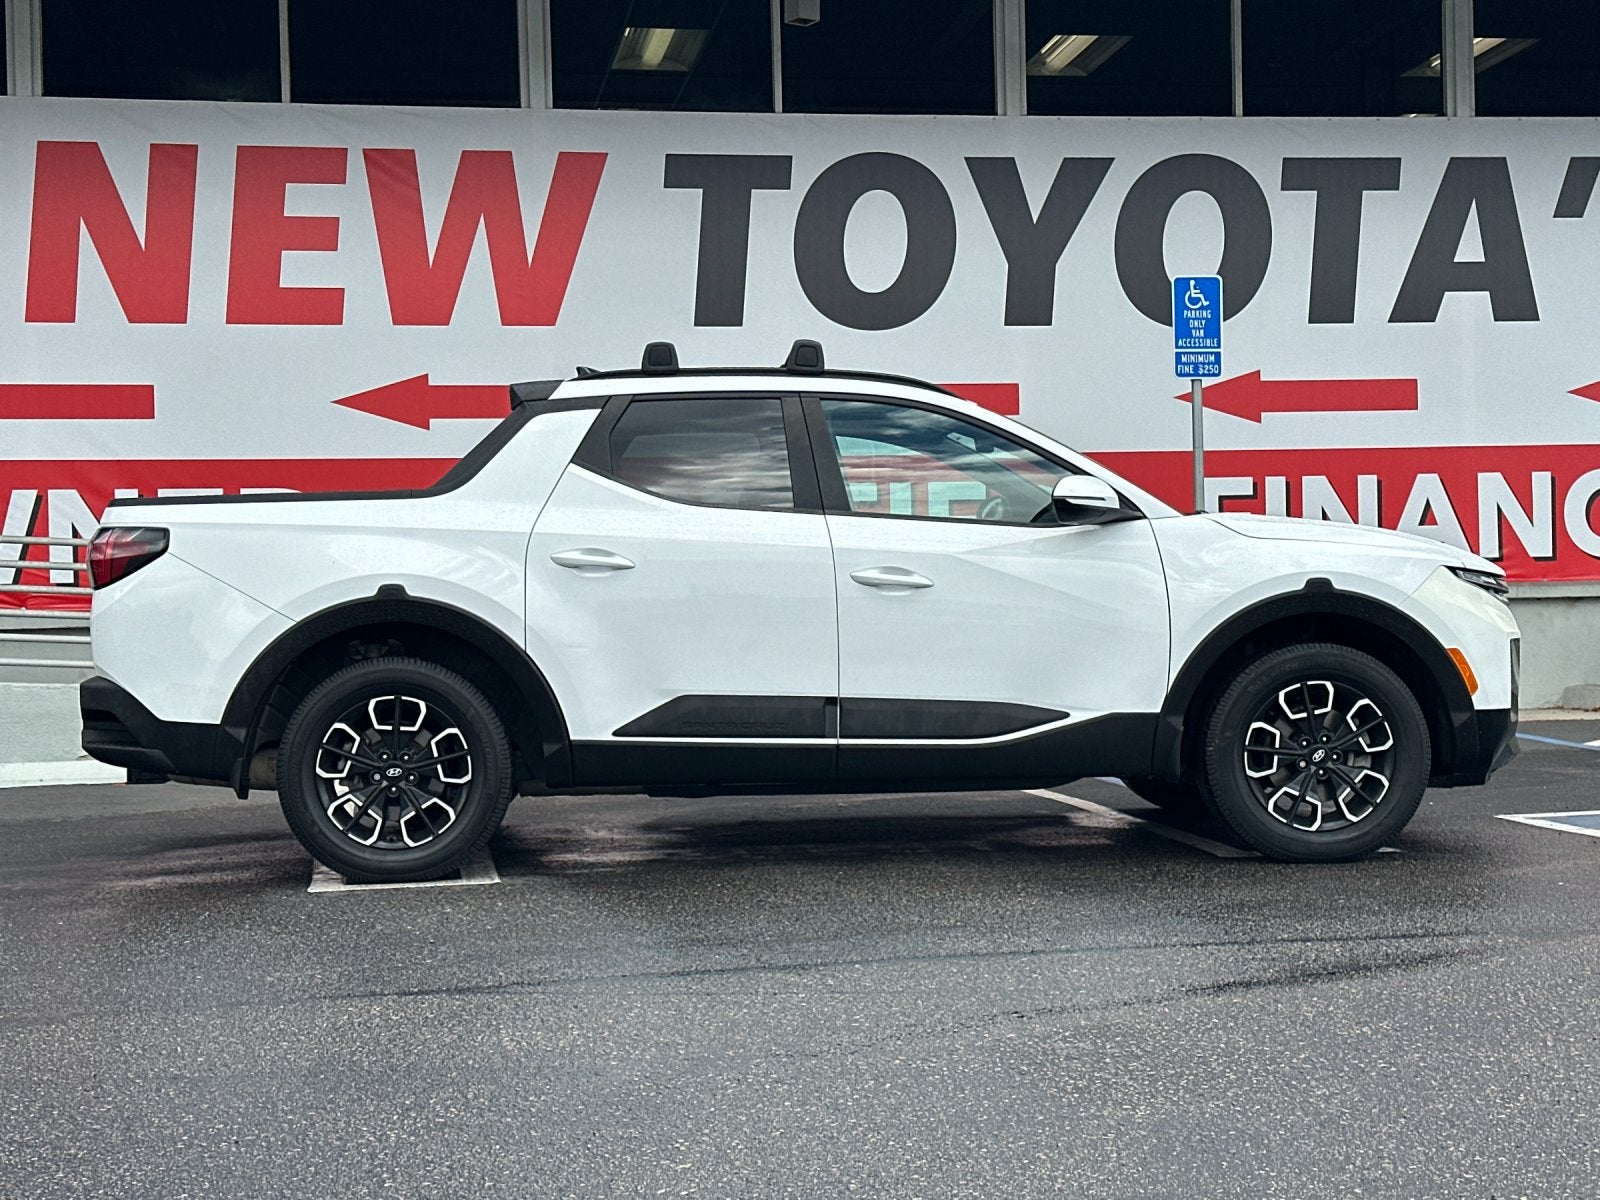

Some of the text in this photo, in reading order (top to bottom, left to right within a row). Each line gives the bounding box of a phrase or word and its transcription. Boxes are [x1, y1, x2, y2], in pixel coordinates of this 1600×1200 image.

[25, 141, 608, 327] NEW
[1183, 310, 1212, 319] PARKING
[1189, 319, 1206, 328] ONLY
[1191, 329, 1204, 338] VAN
[1177, 338, 1218, 347] ACCESSIBLE
[1181, 354, 1215, 363] MINIMUM
[1177, 364, 1219, 375] FINE $250
